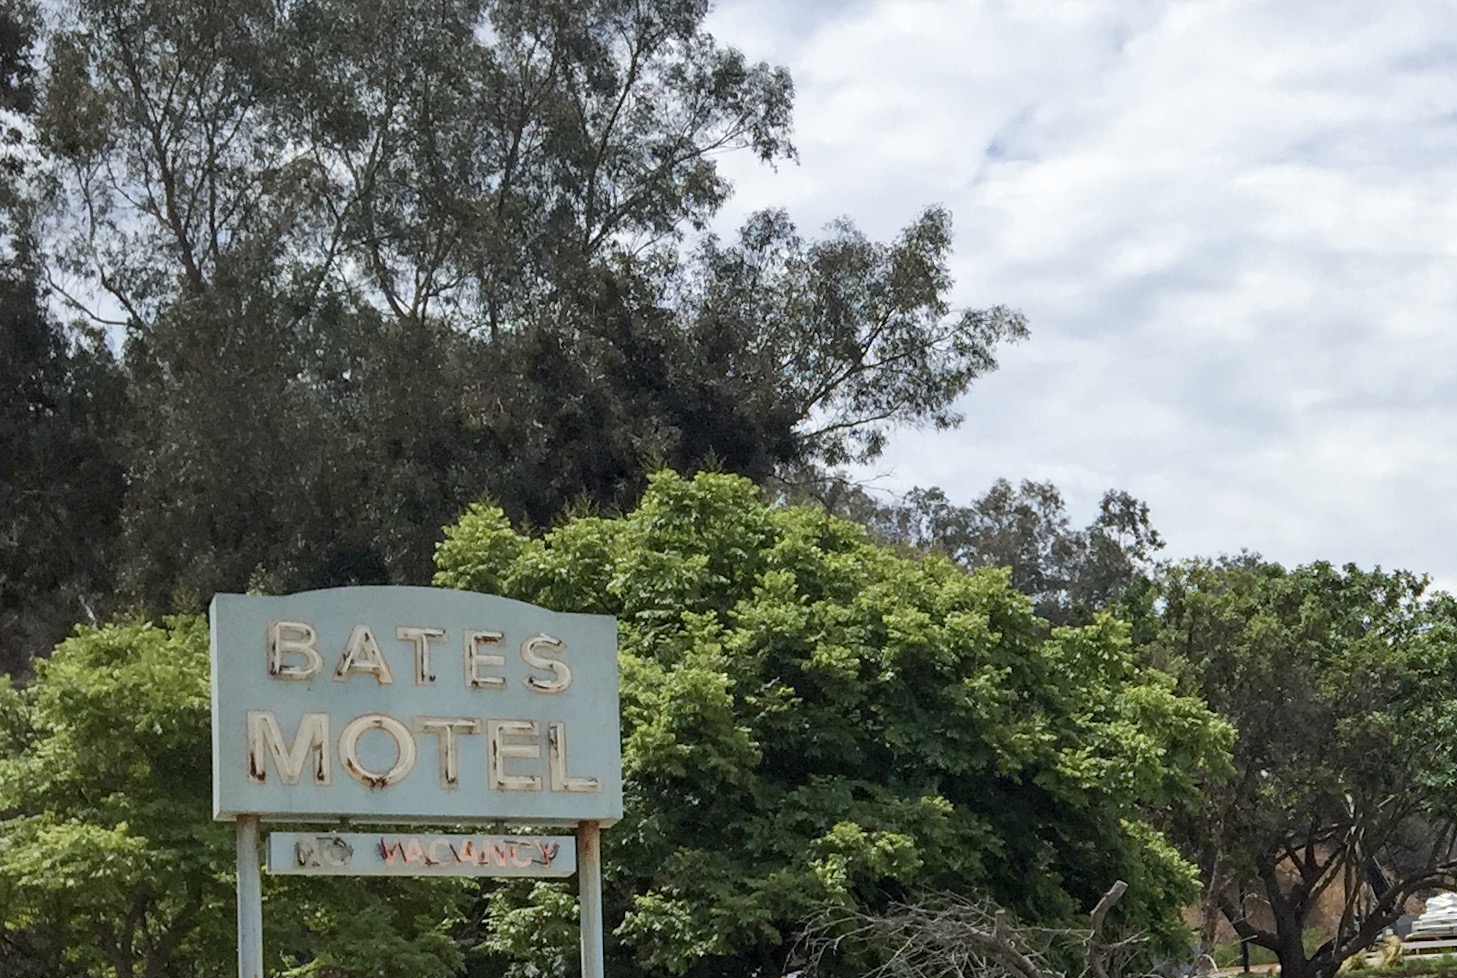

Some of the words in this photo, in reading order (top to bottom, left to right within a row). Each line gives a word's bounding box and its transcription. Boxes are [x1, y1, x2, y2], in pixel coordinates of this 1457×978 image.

[268, 620, 575, 694] BATES
[247, 710, 600, 792] MOTEL
[294, 836, 354, 868] NO
[378, 836, 560, 868] VACANCY
